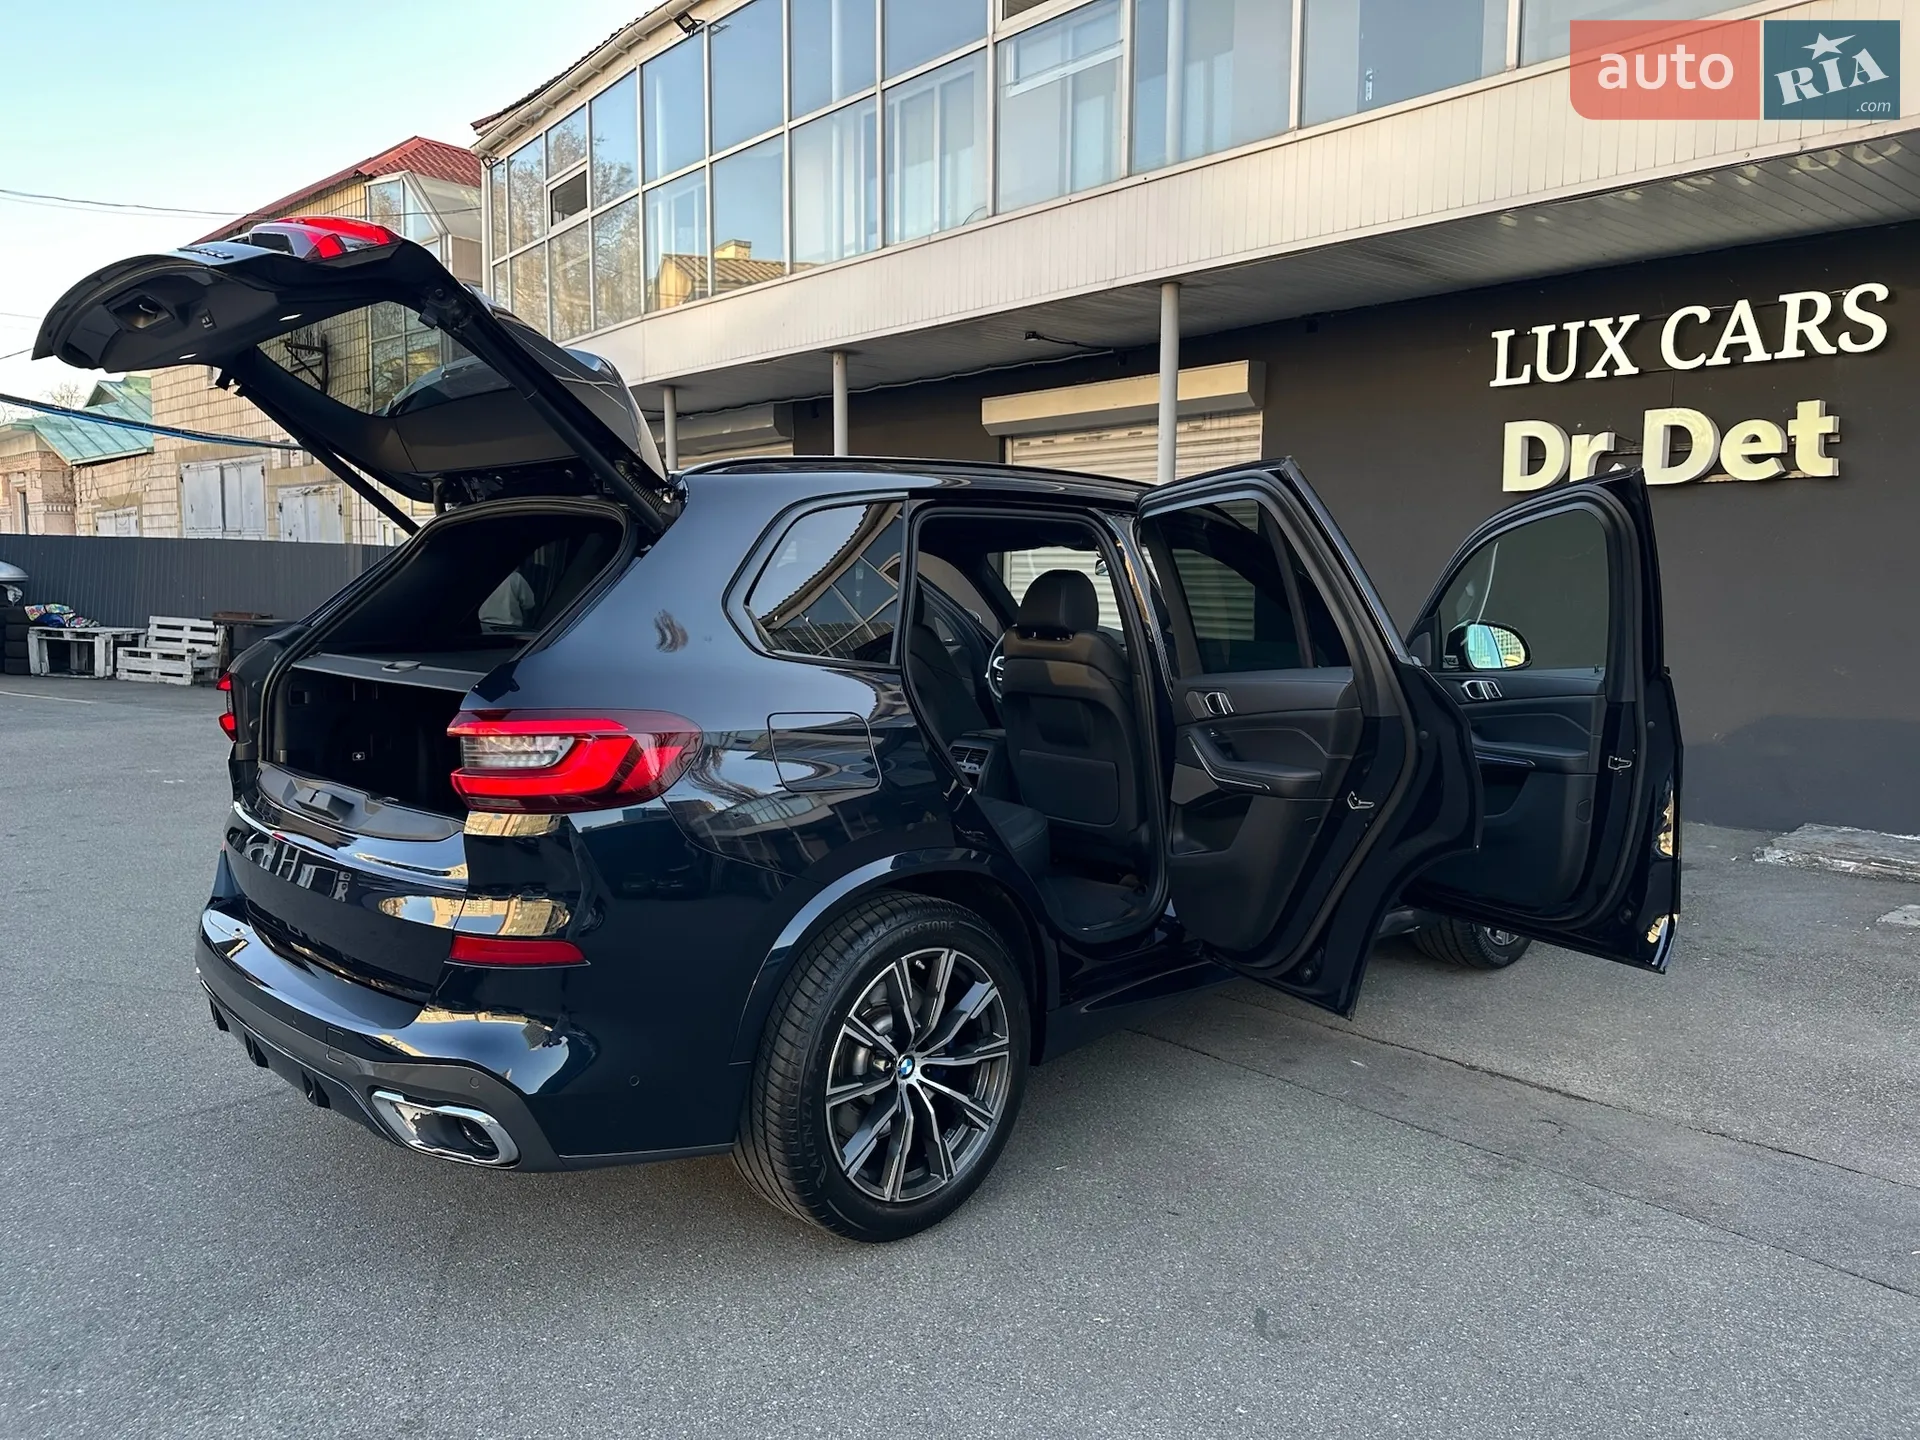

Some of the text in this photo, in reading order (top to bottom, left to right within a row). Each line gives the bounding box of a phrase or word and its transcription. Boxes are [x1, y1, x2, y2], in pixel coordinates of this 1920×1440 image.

[1489, 282, 1889, 387] LUX CARS
[1642, 399, 1840, 485] Det
[802, 1096, 820, 1168] ALENZA
